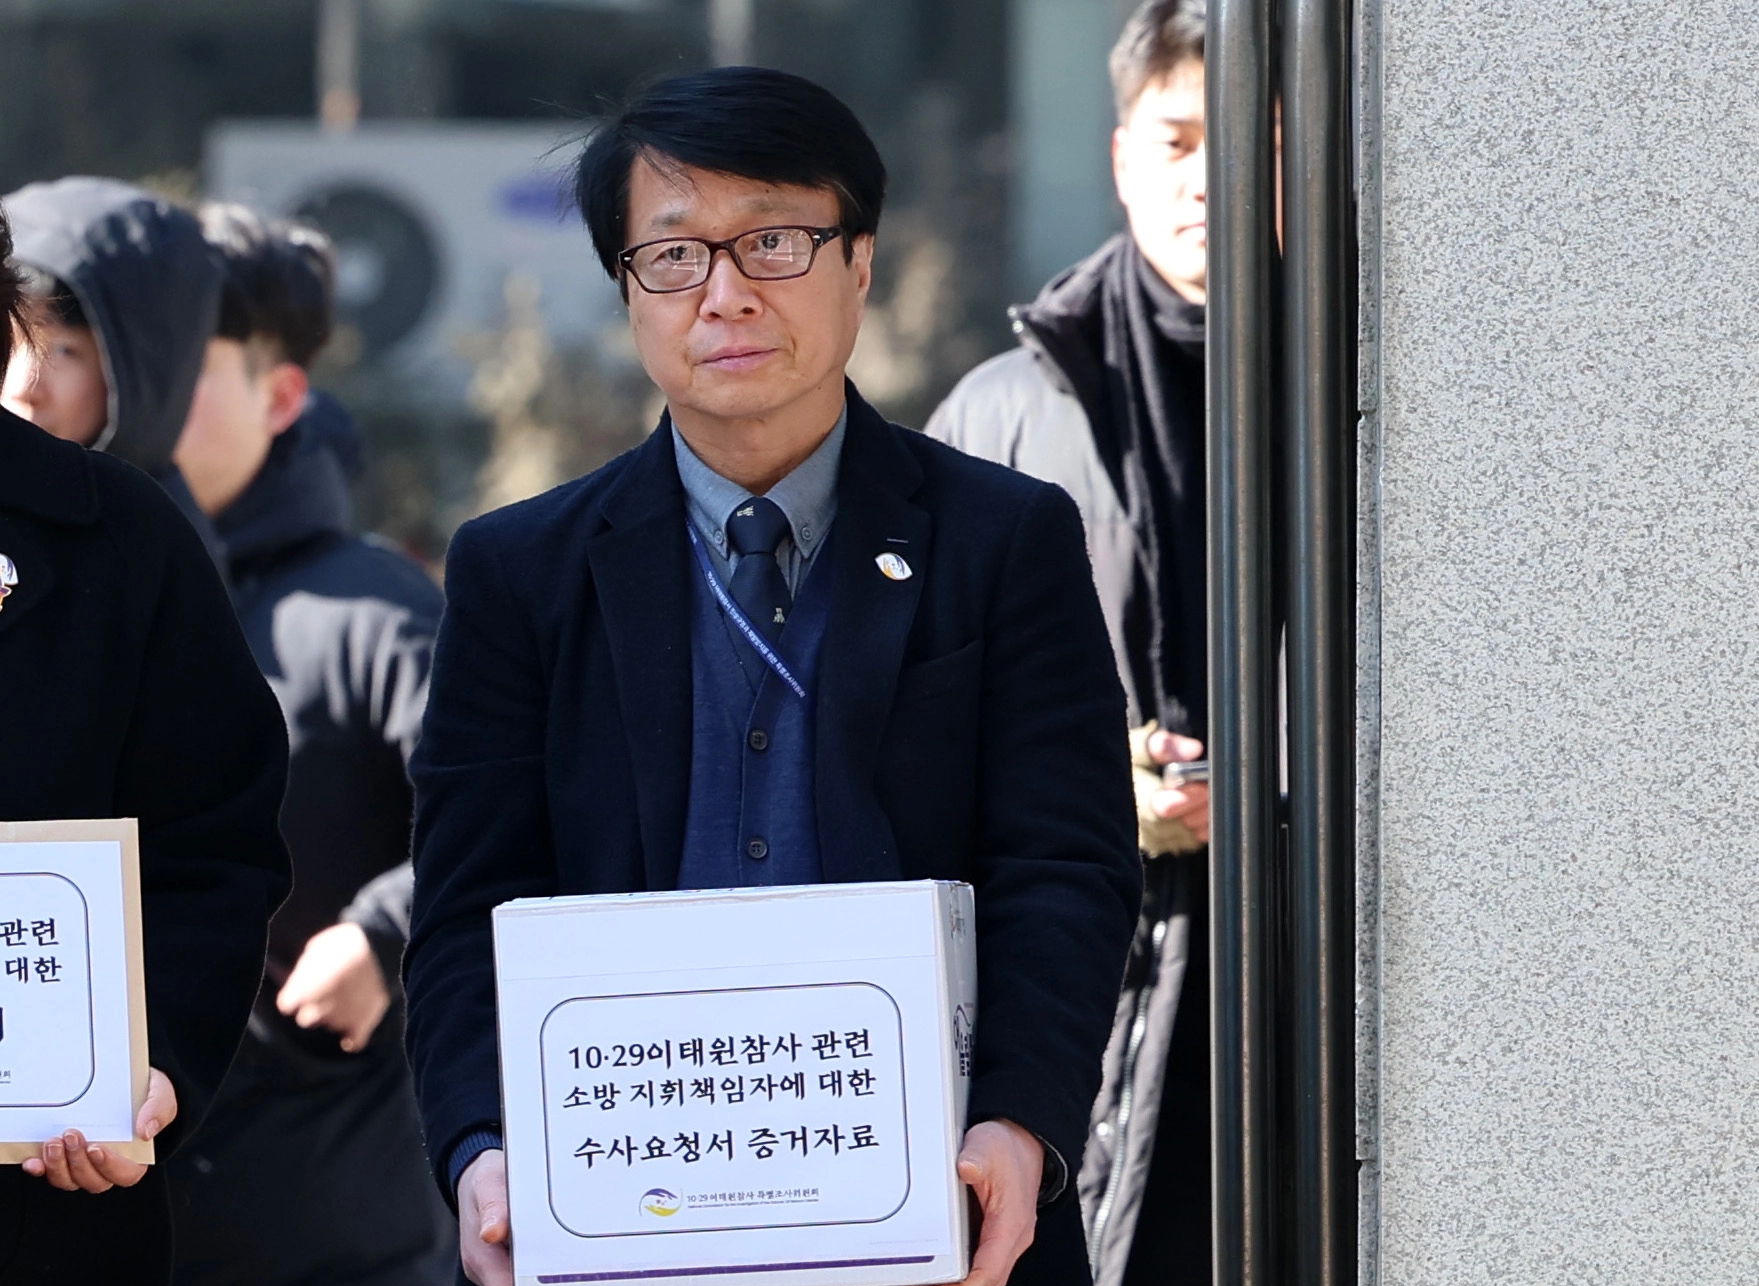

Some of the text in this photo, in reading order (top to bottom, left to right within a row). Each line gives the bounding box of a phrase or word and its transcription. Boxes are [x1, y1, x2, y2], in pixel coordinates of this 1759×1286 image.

[5, 956, 62, 983] 대한
[569, 1029, 873, 1069] 10·29이태원참사 관련
[563, 1068, 876, 1110] 소방 지휘책임자에 대한
[574, 1124, 879, 1168] 수사요청서 증거자료
